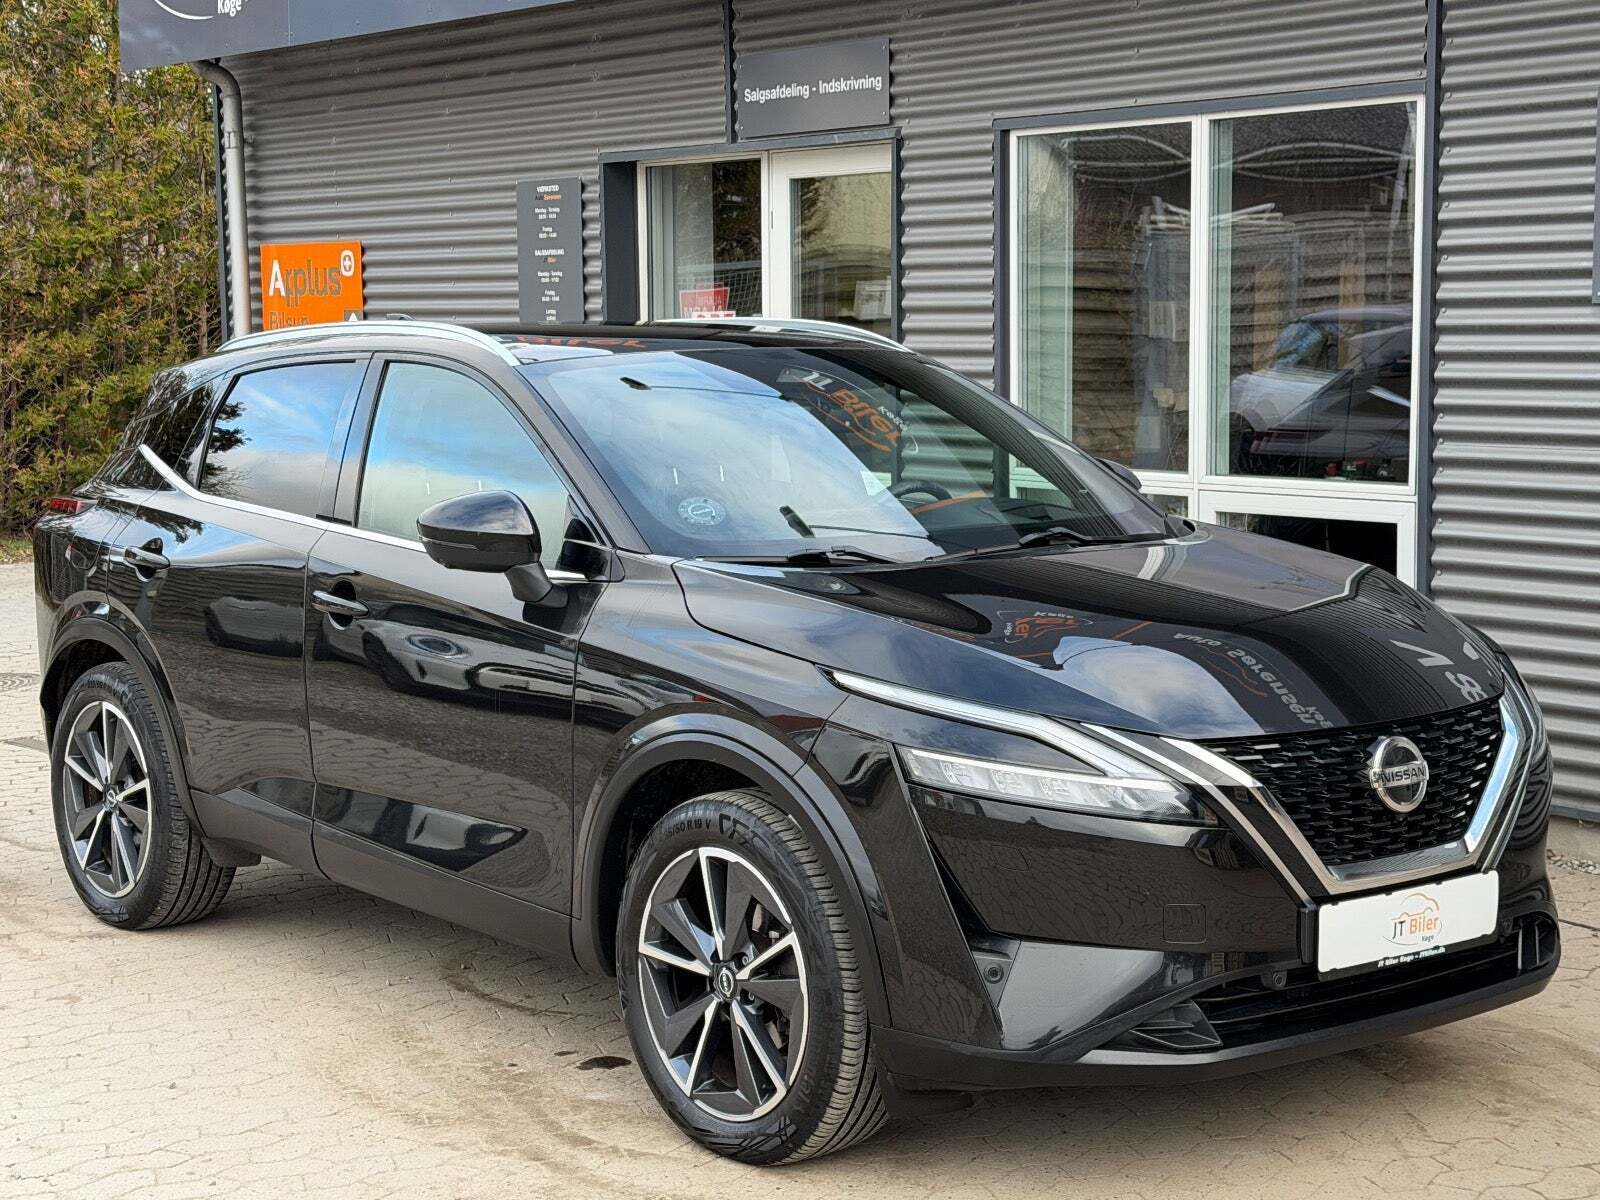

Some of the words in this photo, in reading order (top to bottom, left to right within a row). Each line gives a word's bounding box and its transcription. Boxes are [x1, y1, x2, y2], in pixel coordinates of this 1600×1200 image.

[744, 82, 810, 104] Salgsafdeling
[818, 74, 882, 95] Indskrivning
[1381, 765, 1425, 783] NISSAN
[1392, 920, 1407, 940] JT
[1409, 915, 1440, 935] Biler
